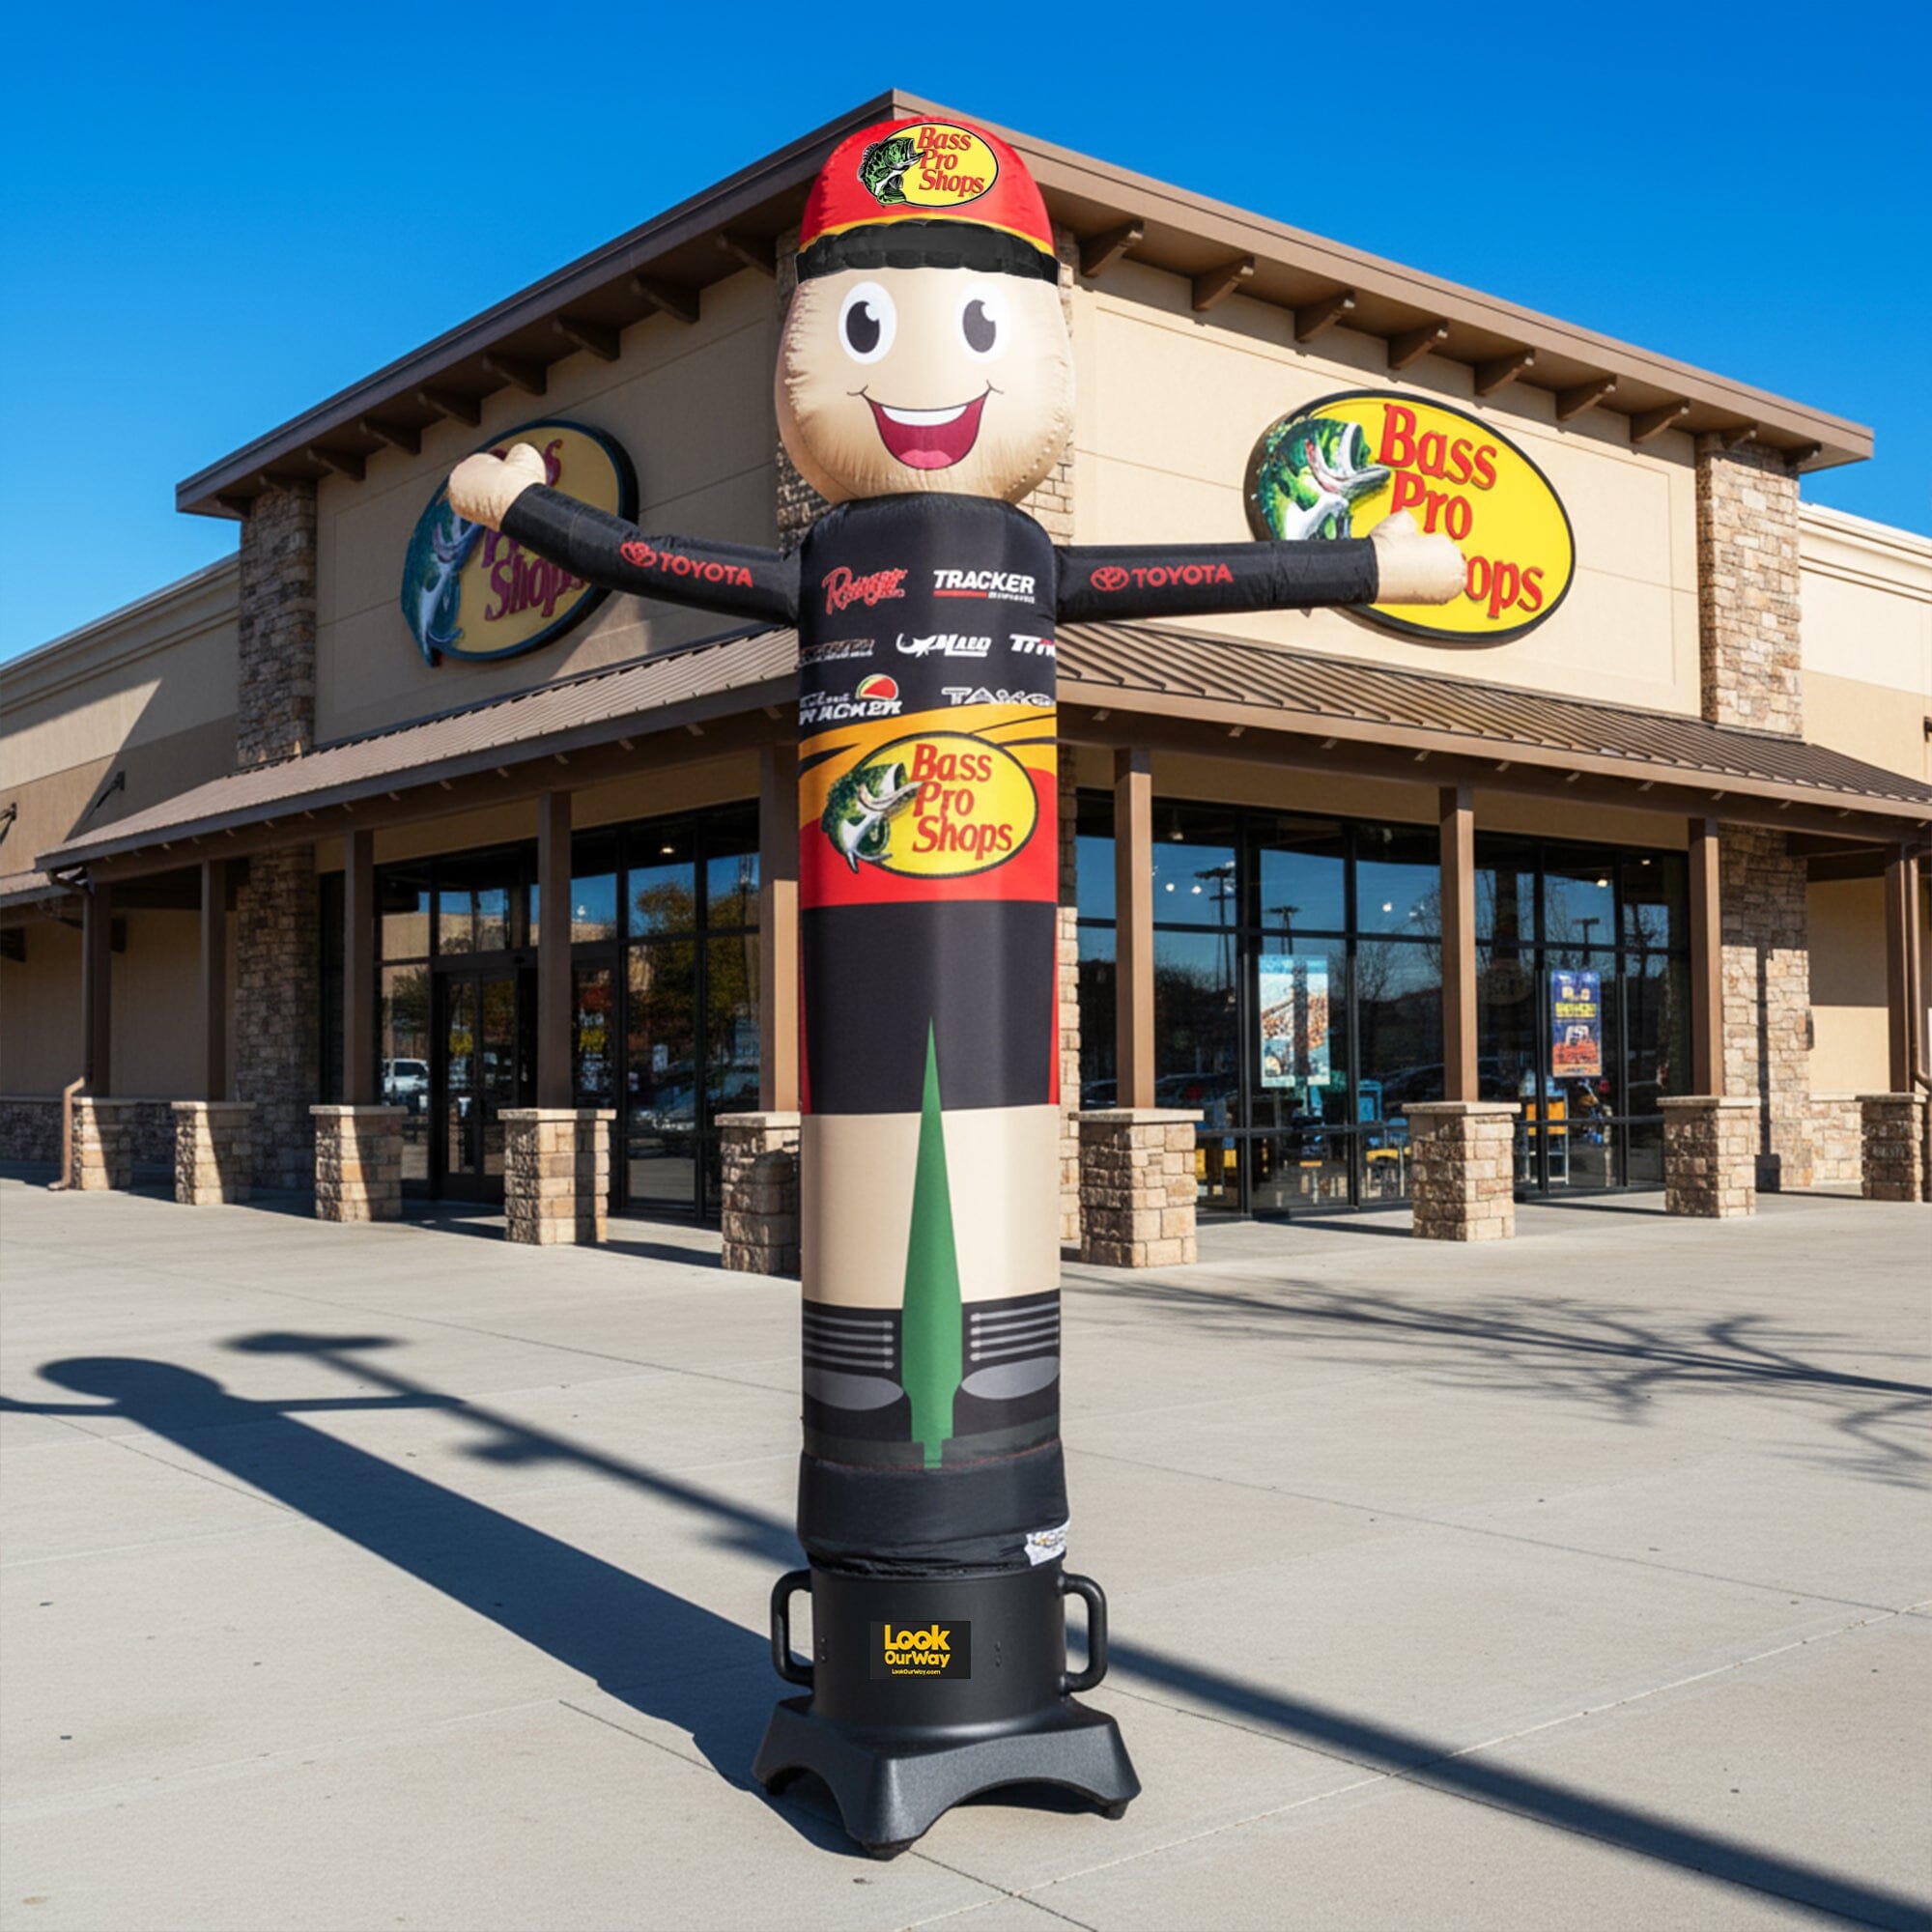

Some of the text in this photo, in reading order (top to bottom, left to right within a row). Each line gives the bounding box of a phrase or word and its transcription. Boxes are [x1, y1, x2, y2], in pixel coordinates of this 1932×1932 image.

[917, 127, 972, 152] Bass
[919, 148, 958, 171] Pro
[919, 169, 984, 197] Shops
[1378, 403, 1497, 490] Bass
[1390, 469, 1473, 541] Pro
[484, 554, 591, 621] Shop
[659, 551, 753, 588] TOYOTA
[933, 569, 1036, 594] TRACKER
[1131, 562, 1235, 589] TOYOTA
[1462, 554, 1545, 620] ops
[910, 743, 993, 782] Bass
[912, 781, 975, 819] Pro
[912, 816, 1013, 861] Shops
[884, 1624, 951, 1650] Look
[884, 1650, 951, 1668] OurWay
